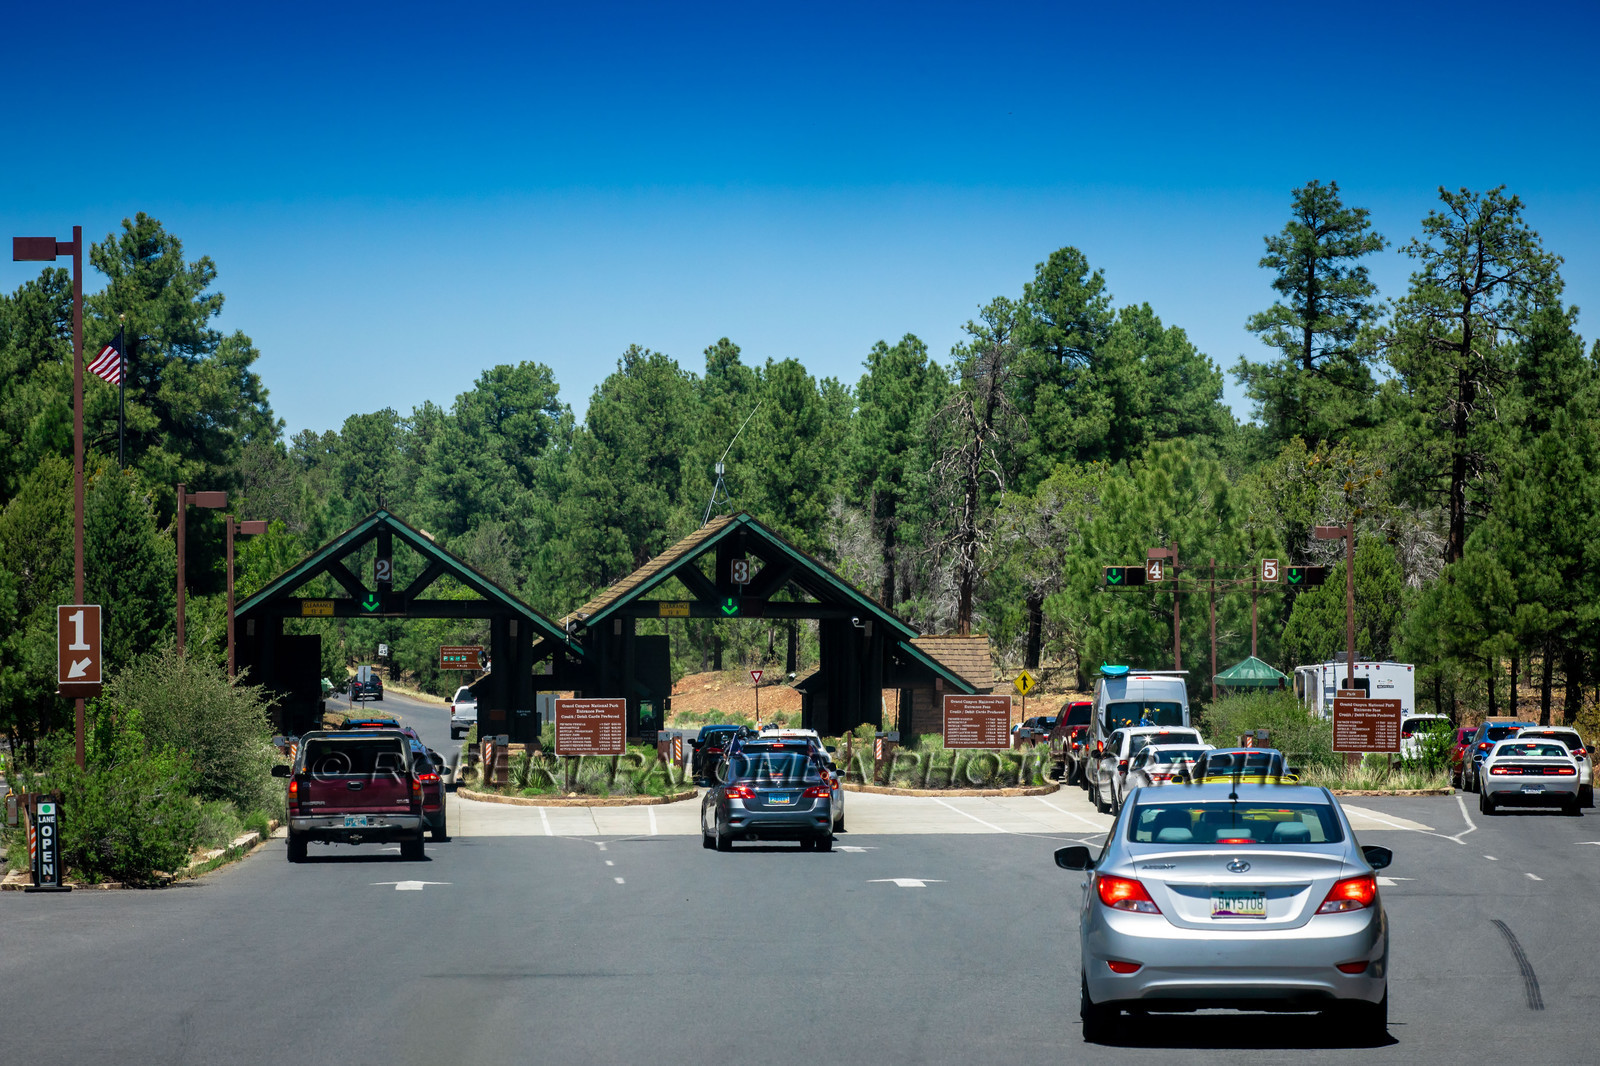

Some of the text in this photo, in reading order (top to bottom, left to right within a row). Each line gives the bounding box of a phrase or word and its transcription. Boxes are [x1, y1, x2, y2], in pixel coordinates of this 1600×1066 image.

[376, 559, 390, 580] 2
[734, 561, 747, 582] 3
[1149, 561, 1161, 579] 4
[1263, 562, 1277, 579] 5
[69, 610, 90, 650] 1
[41, 825, 54, 875] OPEN
[1218, 896, 1264, 910] BWY5708
